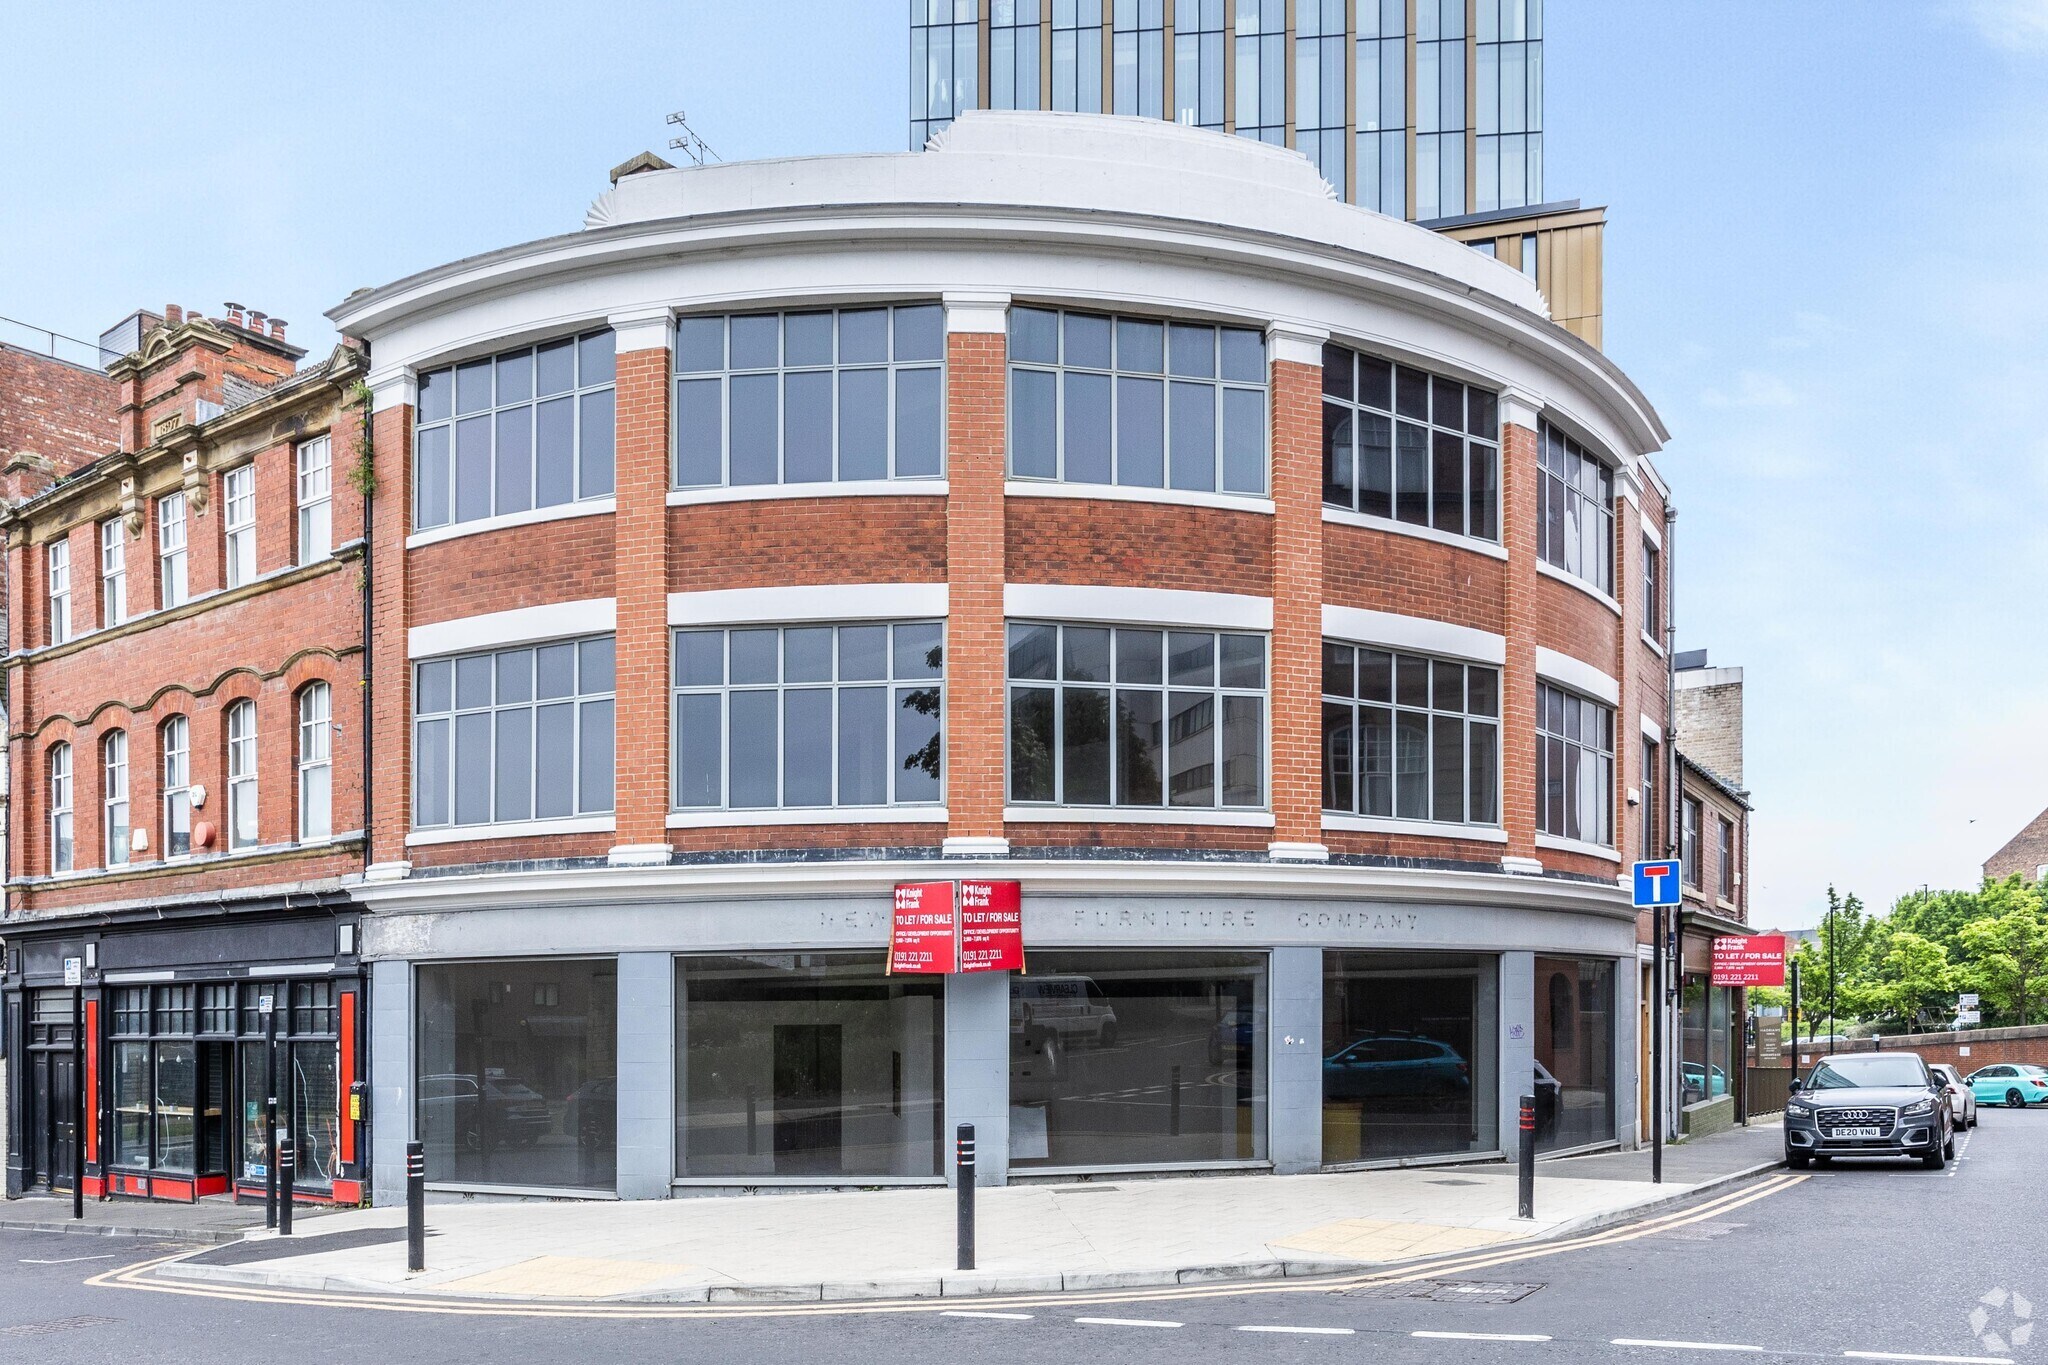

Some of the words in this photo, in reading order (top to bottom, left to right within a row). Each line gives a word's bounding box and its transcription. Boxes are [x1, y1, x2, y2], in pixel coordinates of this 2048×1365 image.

[159, 418, 180, 435] 1897
[907, 888, 922, 900] Knight
[975, 885, 992, 897] Knight
[906, 900, 920, 909] Frank
[975, 896, 989, 906] Frank
[896, 915, 904, 925] TO
[905, 914, 916, 925] LET
[920, 914, 933, 924] FOR
[934, 913, 952, 924] SALE
[963, 912, 972, 923] TO
[973, 912, 985, 923] LET
[990, 912, 1002, 922] FOR
[1003, 912, 1018, 922] SALE
[1074, 910, 1255, 927] FURNITURE
[1297, 912, 1418, 930] COMPANY
[894, 952, 907, 962] 0191
[908, 952, 918, 961] 221
[919, 952, 933, 961] 2211
[963, 951, 977, 961] 0191
[978, 950, 988, 960] 221
[989, 949, 1002, 959] 2211
[1835, 1128, 1858, 1136] DE20
[1860, 1128, 1876, 1136] VNU
